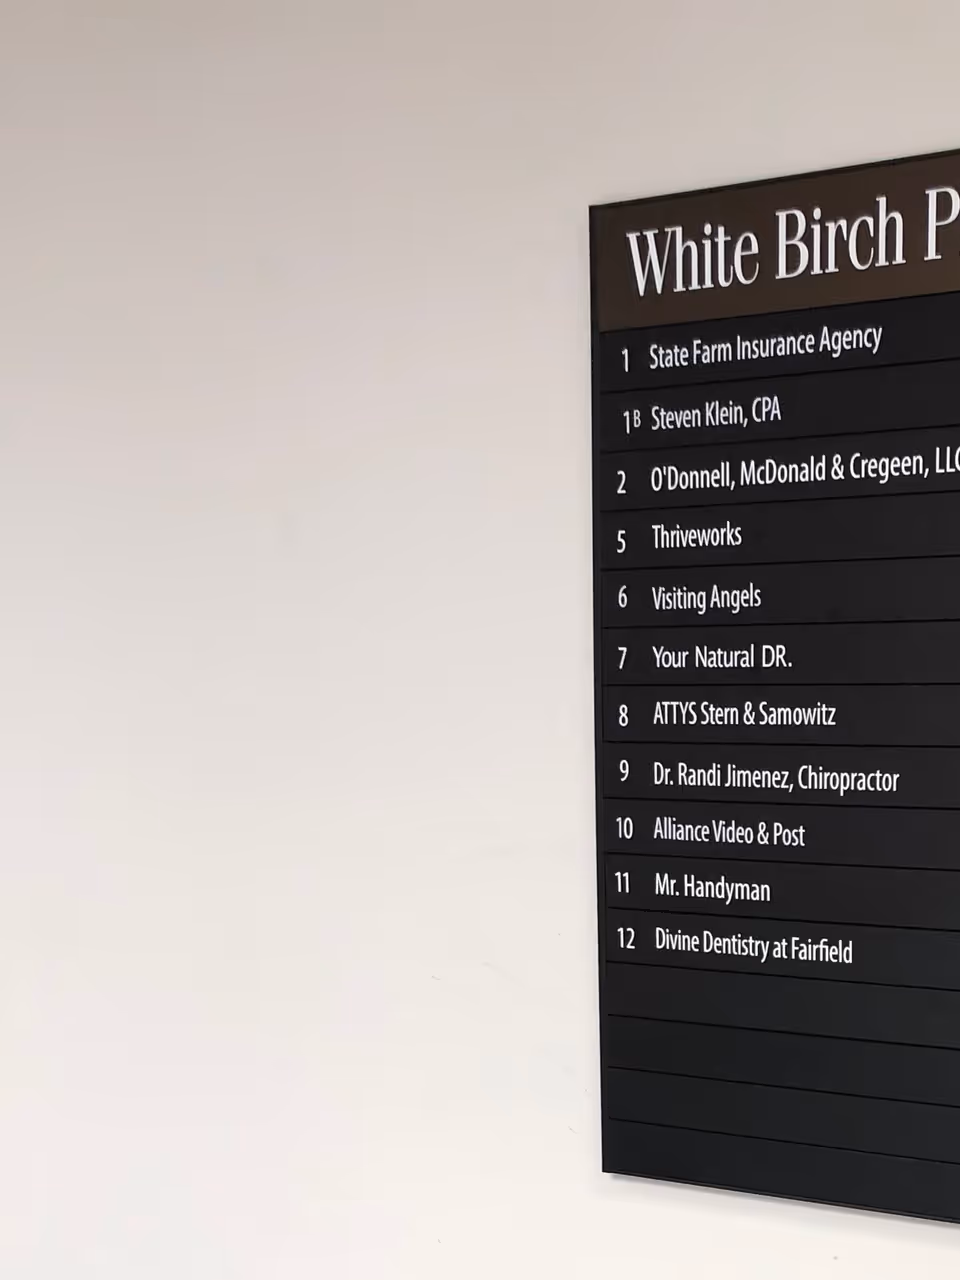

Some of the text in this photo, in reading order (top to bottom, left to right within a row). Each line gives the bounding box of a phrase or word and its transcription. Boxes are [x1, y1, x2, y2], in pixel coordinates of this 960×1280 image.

[625, 222, 760, 297] White
[774, 195, 907, 280] Birch
[621, 325, 883, 373] 1 State Farm Insurance Agency
[651, 405, 701, 431] Steven
[705, 400, 749, 428] Klein,
[751, 395, 782, 423] CPA
[616, 470, 627, 495] 2
[650, 461, 736, 493] O'Donnell,
[740, 453, 826, 489] McDonald
[830, 453, 845, 481] &
[849, 452, 930, 485] Cregeen,
[616, 520, 742, 554] 5 Thriveworks
[618, 582, 762, 615] 6 Visiting Angels
[617, 643, 793, 670] 7 Your Natural DR.
[618, 700, 837, 727] 8 ATTYS Stern & Samowitz
[619, 759, 900, 797] 9 Dr. Randi Jimenez, Chiropractor
[615, 816, 806, 847] 10 Alliance Video & Post
[614, 871, 771, 906] 11 Mr. Handyman
[617, 926, 853, 964] 12 Divine Dentistry at Fairfield
